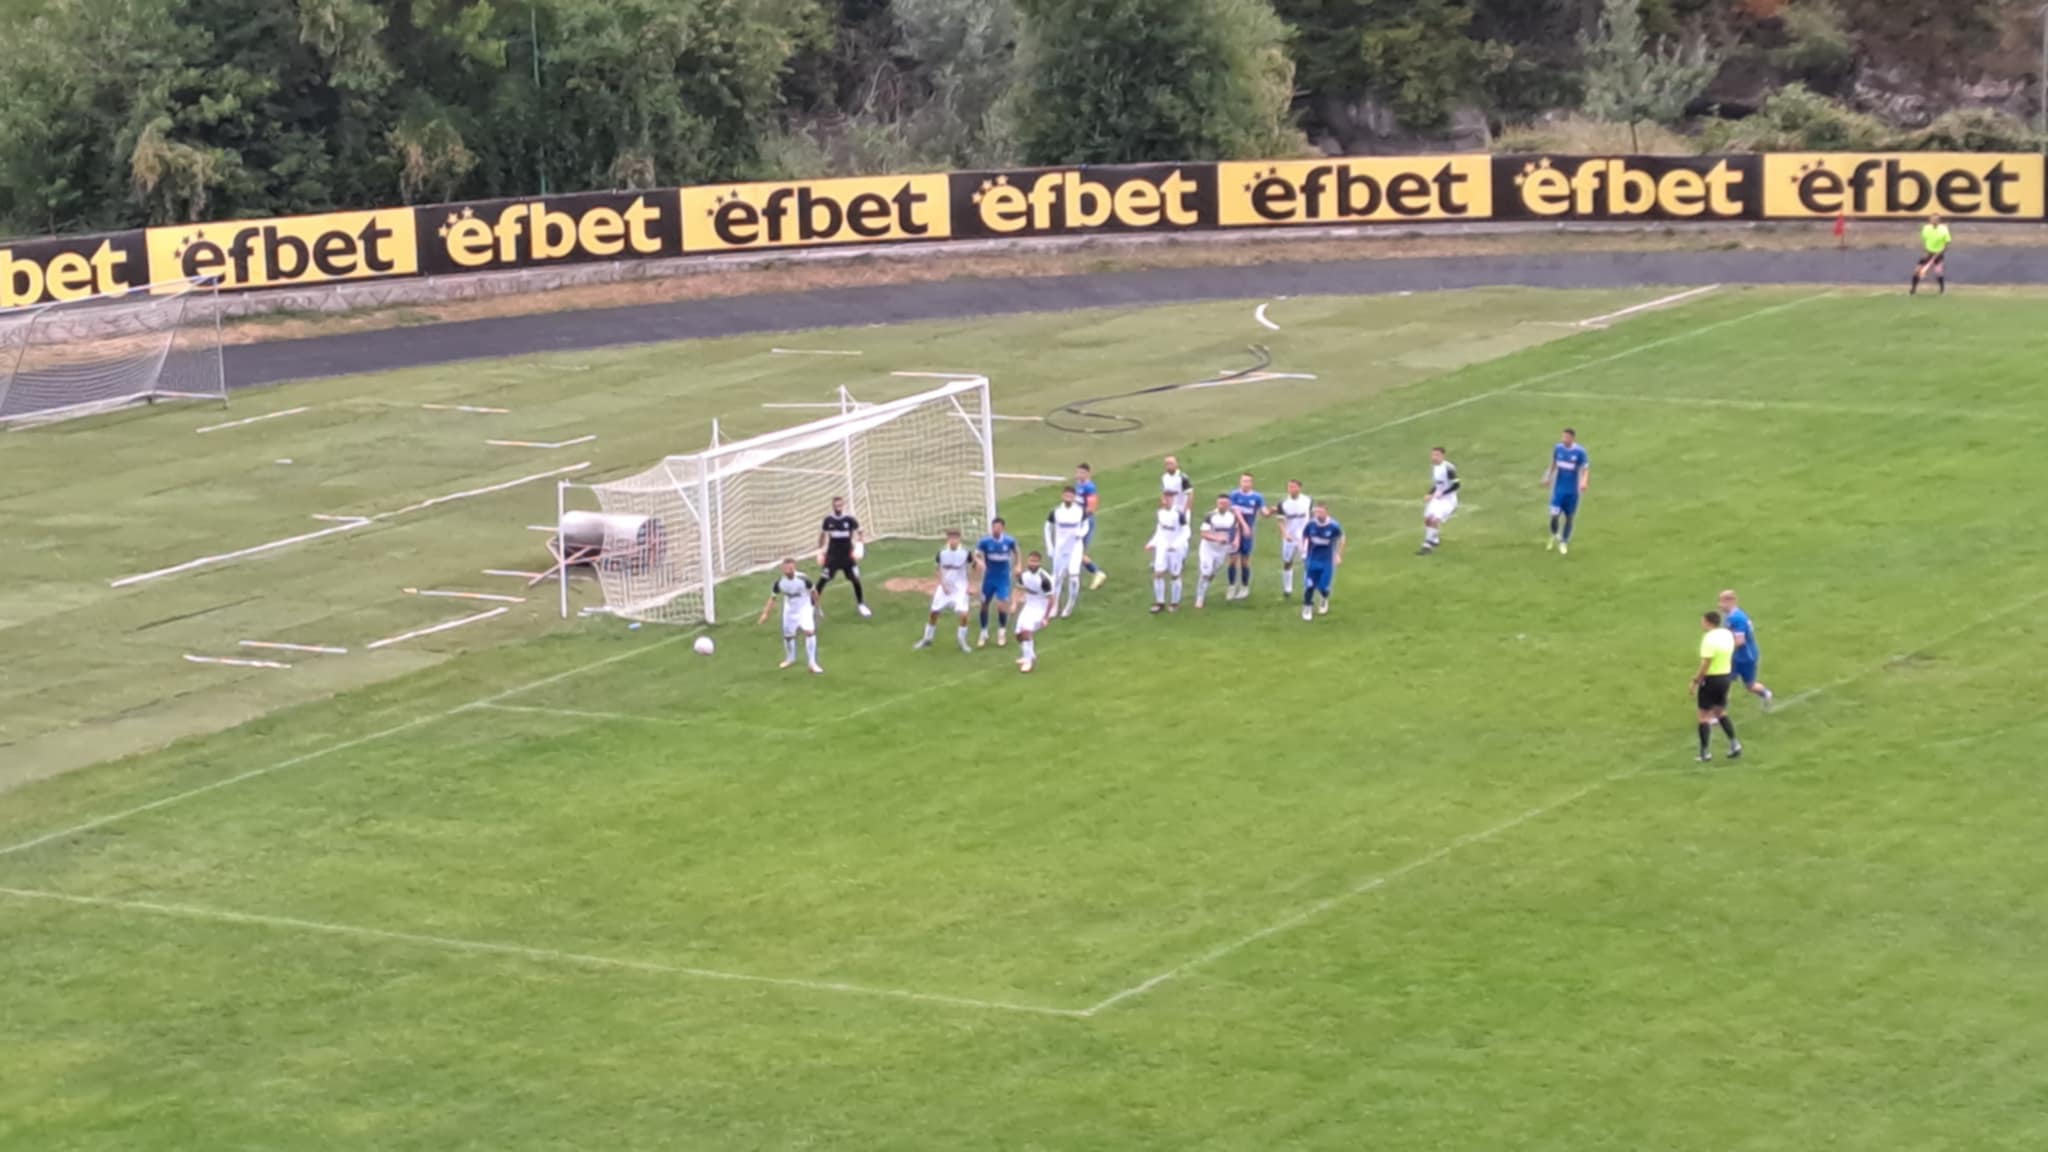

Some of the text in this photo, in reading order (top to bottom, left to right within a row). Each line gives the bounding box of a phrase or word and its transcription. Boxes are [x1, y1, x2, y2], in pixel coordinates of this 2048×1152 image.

[714, 181, 929, 245] efbet
[979, 169, 1199, 232] efbet
[1251, 162, 1469, 220] efbet
[1521, 159, 1744, 216] efbet
[1800, 160, 2020, 214] efbet
[181, 217, 395, 285] efbet
[445, 196, 662, 266] efbet
[0, 239, 130, 308] bet
